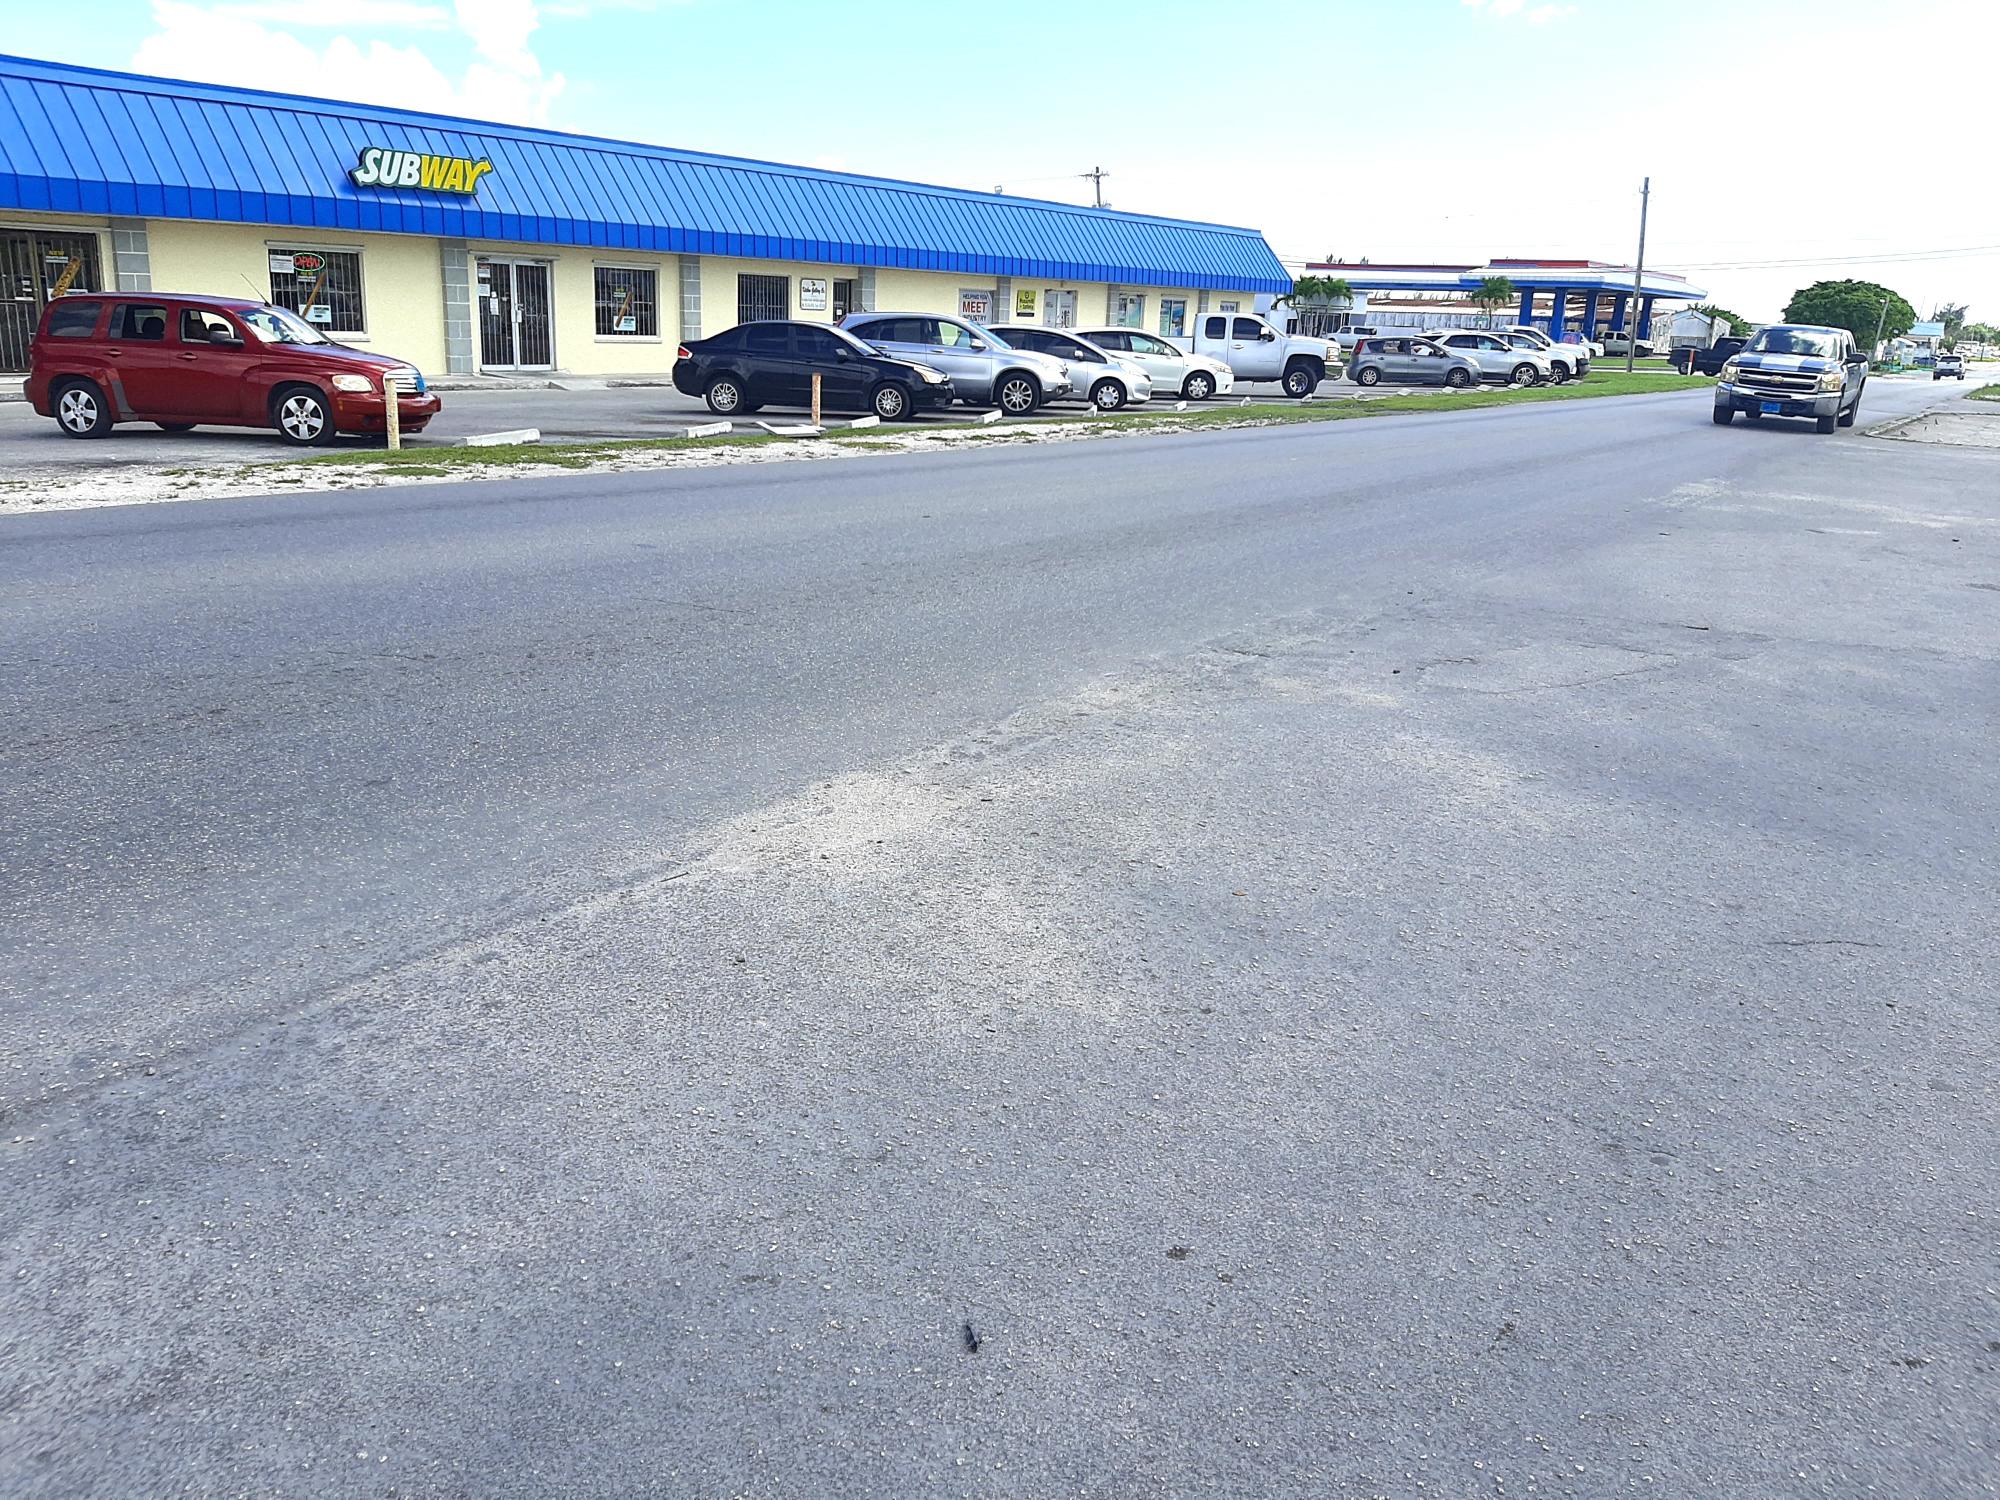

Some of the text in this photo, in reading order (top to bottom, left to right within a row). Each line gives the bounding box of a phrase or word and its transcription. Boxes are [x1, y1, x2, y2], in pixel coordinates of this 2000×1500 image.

[354, 148, 492, 192] SUBWAY
[294, 256, 320, 268] OPEN
[962, 301, 988, 313] MEET
